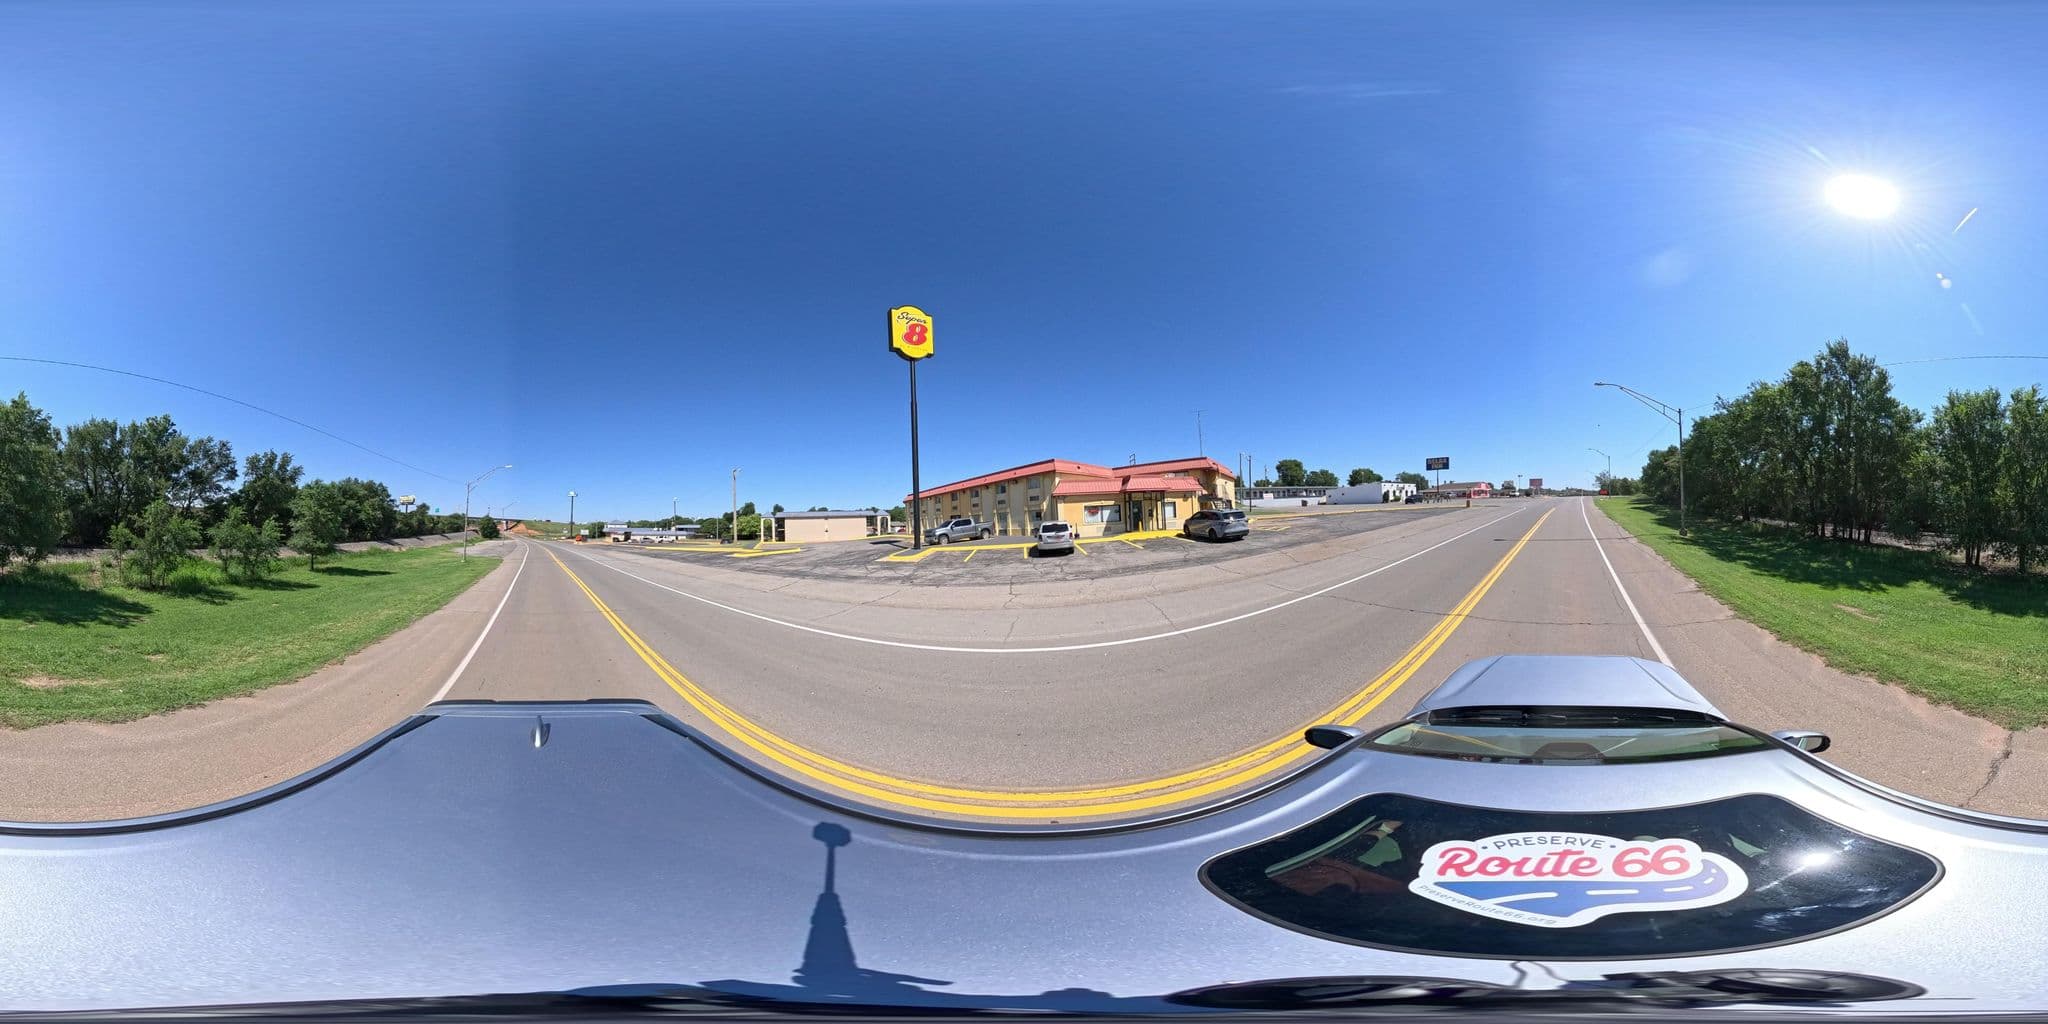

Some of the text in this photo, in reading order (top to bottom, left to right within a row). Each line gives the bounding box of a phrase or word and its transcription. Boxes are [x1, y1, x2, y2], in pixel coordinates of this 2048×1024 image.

[897, 312, 927, 325] Super
[903, 323, 928, 346] 8
[1493, 835, 1606, 850] PRESERVE
[1436, 845, 1691, 878] Route 66
[1419, 884, 1558, 926] PreserveRoute66.org
